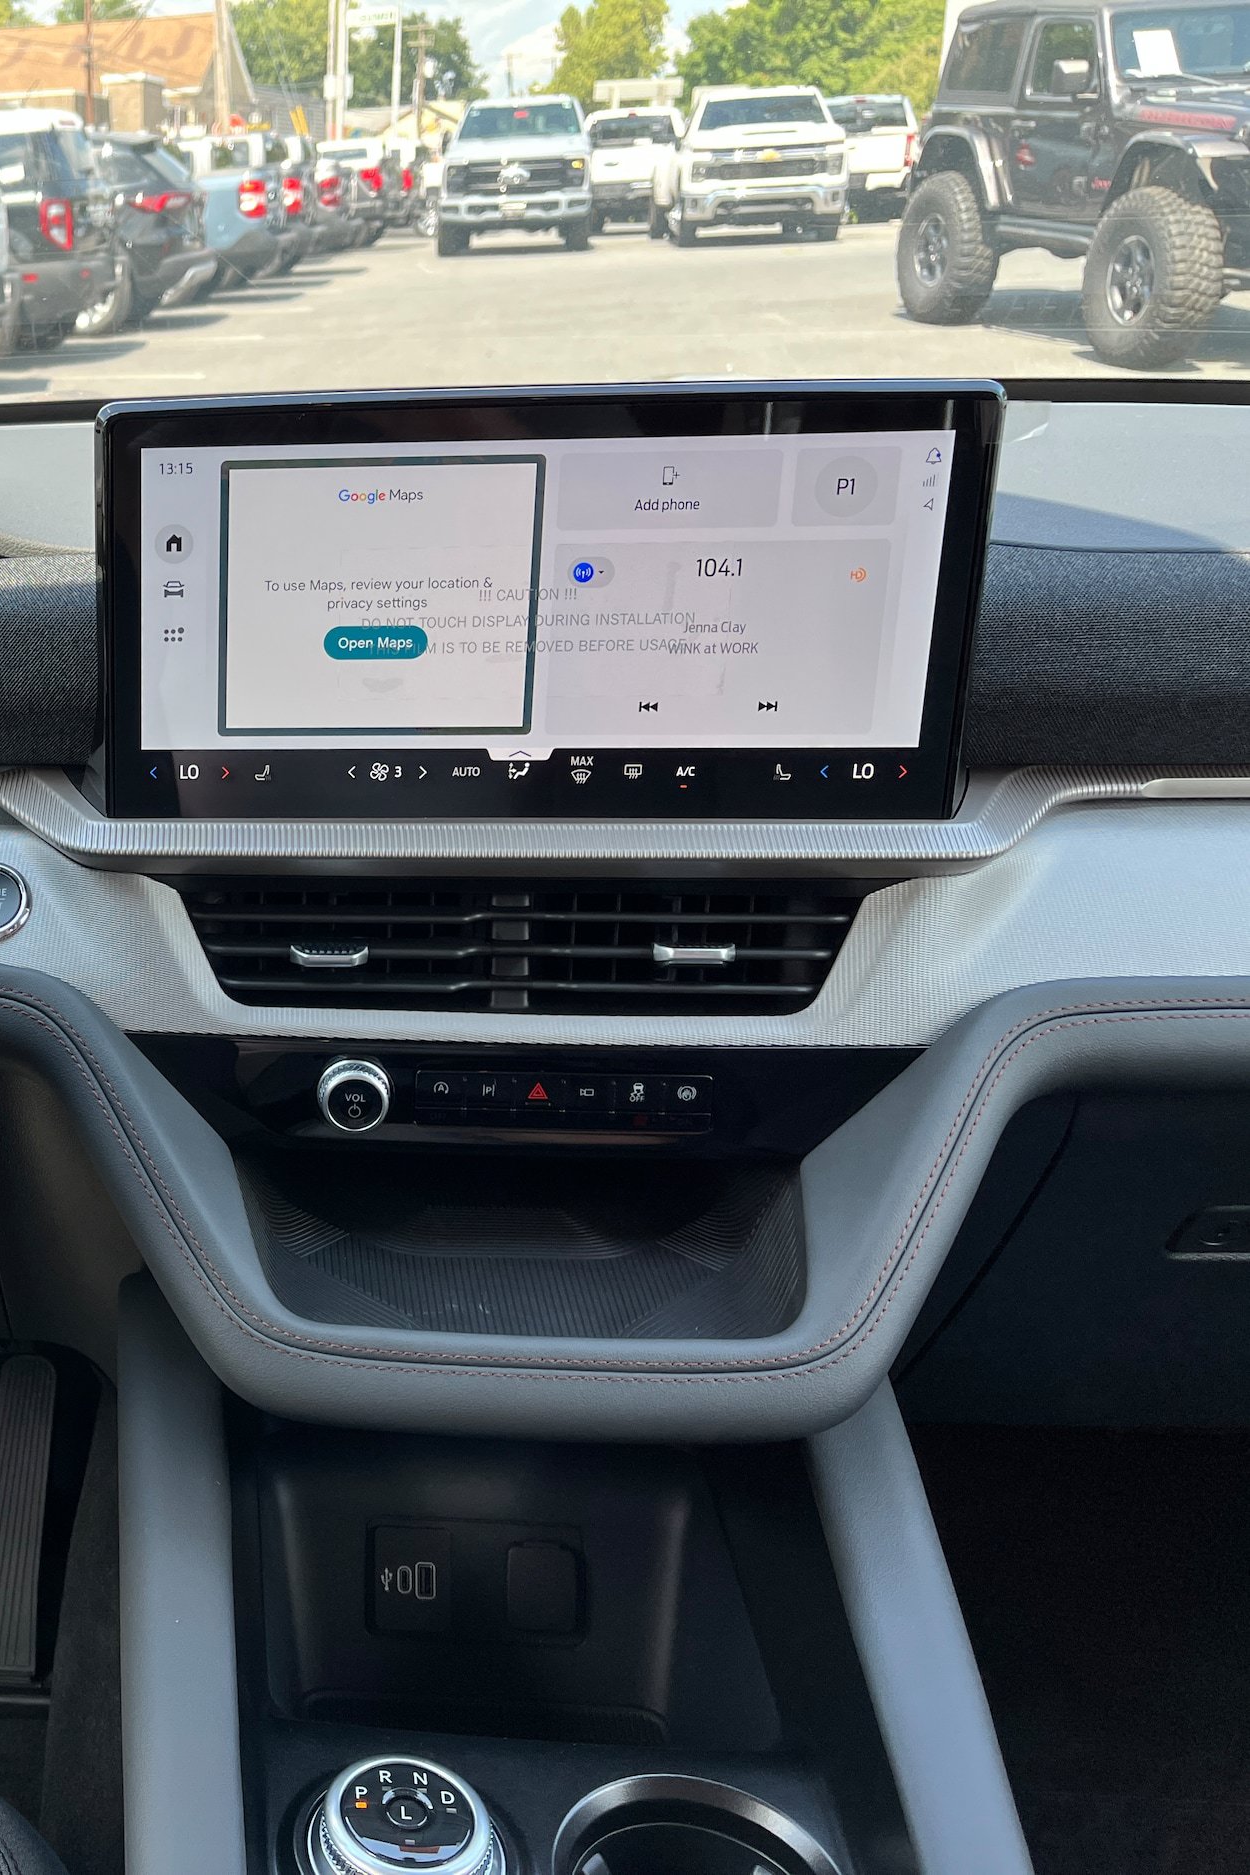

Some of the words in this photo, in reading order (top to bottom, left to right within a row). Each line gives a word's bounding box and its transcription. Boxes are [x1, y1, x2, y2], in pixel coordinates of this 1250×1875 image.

[159, 463, 193, 475] 13:15
[836, 478, 856, 496] P1
[338, 489, 386, 504] Google
[389, 488, 423, 502] Maps
[634, 499, 659, 511] Add
[661, 497, 700, 513] phone
[696, 558, 743, 577] 104.1
[265, 580, 281, 591] To
[286, 581, 306, 591] use
[310, 580, 347, 593] Maps,
[350, 579, 391, 590] review
[395, 579, 424, 592] your
[428, 577, 479, 589] location
[483, 577, 493, 589] &
[496, 588, 559, 602] CAUTION
[565, 588, 577, 600] !!!
[327, 597, 373, 612] privacy
[376, 596, 428, 610] settings
[361, 618, 381, 629] DO
[386, 617, 414, 629] NOT
[419, 616, 467, 628] TOUCH
[472, 614, 529, 628] DISPLAY
[535, 614, 590, 627] DURING
[595, 612, 696, 626] INSTALLATION
[683, 622, 718, 634] Jenna
[721, 621, 746, 635] Clay
[338, 638, 372, 651] Open
[376, 636, 413, 651] Maps
[442, 642, 455, 654] IS
[459, 642, 478, 653] TO
[482, 641, 500, 653] BE
[505, 640, 574, 653] REMOVED
[579, 639, 635, 652] BEFORE
[639, 639, 687, 651] USAGE
[668, 642, 701, 654] WINK
[704, 643, 716, 654] at
[720, 642, 758, 654] WORK
[570, 756, 593, 766] MAX
[179, 764, 200, 780] LO
[394, 767, 402, 778] 3
[452, 766, 480, 777] AUTO
[676, 767, 695, 777] A/C
[852, 763, 874, 780] LO
[345, 1093, 366, 1102] VOL
[379, 1770, 392, 1783] R
[413, 1772, 428, 1785] N
[355, 1786, 368, 1799] P
[441, 1791, 455, 1804] D
[401, 1806, 412, 1820] L
